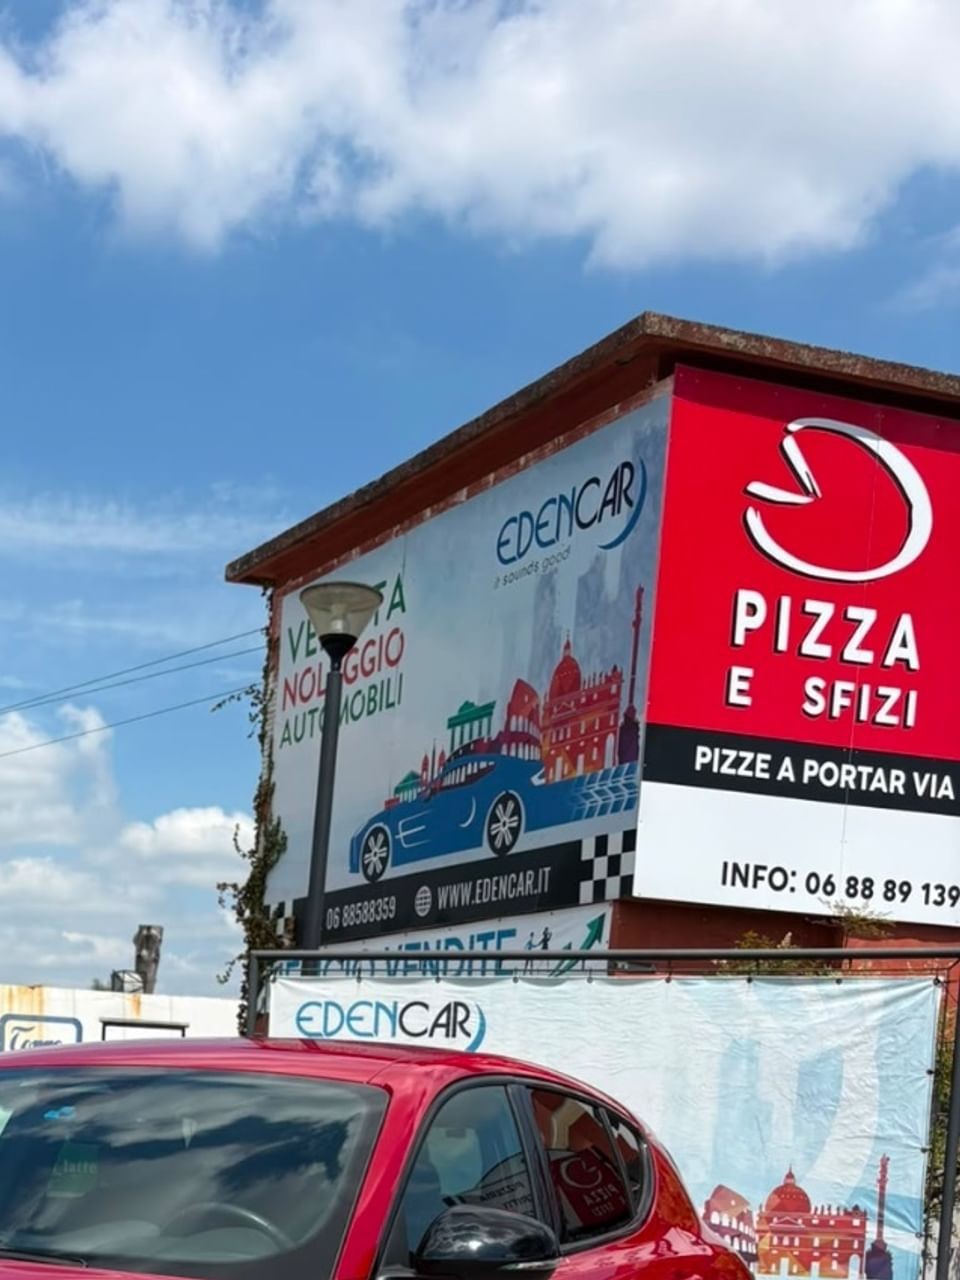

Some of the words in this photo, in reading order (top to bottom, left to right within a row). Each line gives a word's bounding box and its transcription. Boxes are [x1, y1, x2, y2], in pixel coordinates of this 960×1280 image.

[497, 461, 635, 565] EDENCAR
[731, 588, 920, 671] PIZZA
[282, 626, 405, 712] NOLGGIO
[727, 666, 754, 707] E
[801, 676, 917, 728] SFIZI
[694, 745, 772, 780] PIZZE
[776, 756, 796, 783] A
[802, 759, 906, 795] PORTAR
[913, 771, 955, 800] VIA
[326, 905, 339, 931] 06
[342, 896, 397, 927] 88588359
[437, 867, 551, 910] WWW.EDENCAR.IT
[721, 861, 797, 893] INFO:
[805, 872, 836, 897] 06
[845, 876, 874, 900] 88
[883, 880, 912, 903] 89
[295, 1000, 472, 1038] EDENCAR
